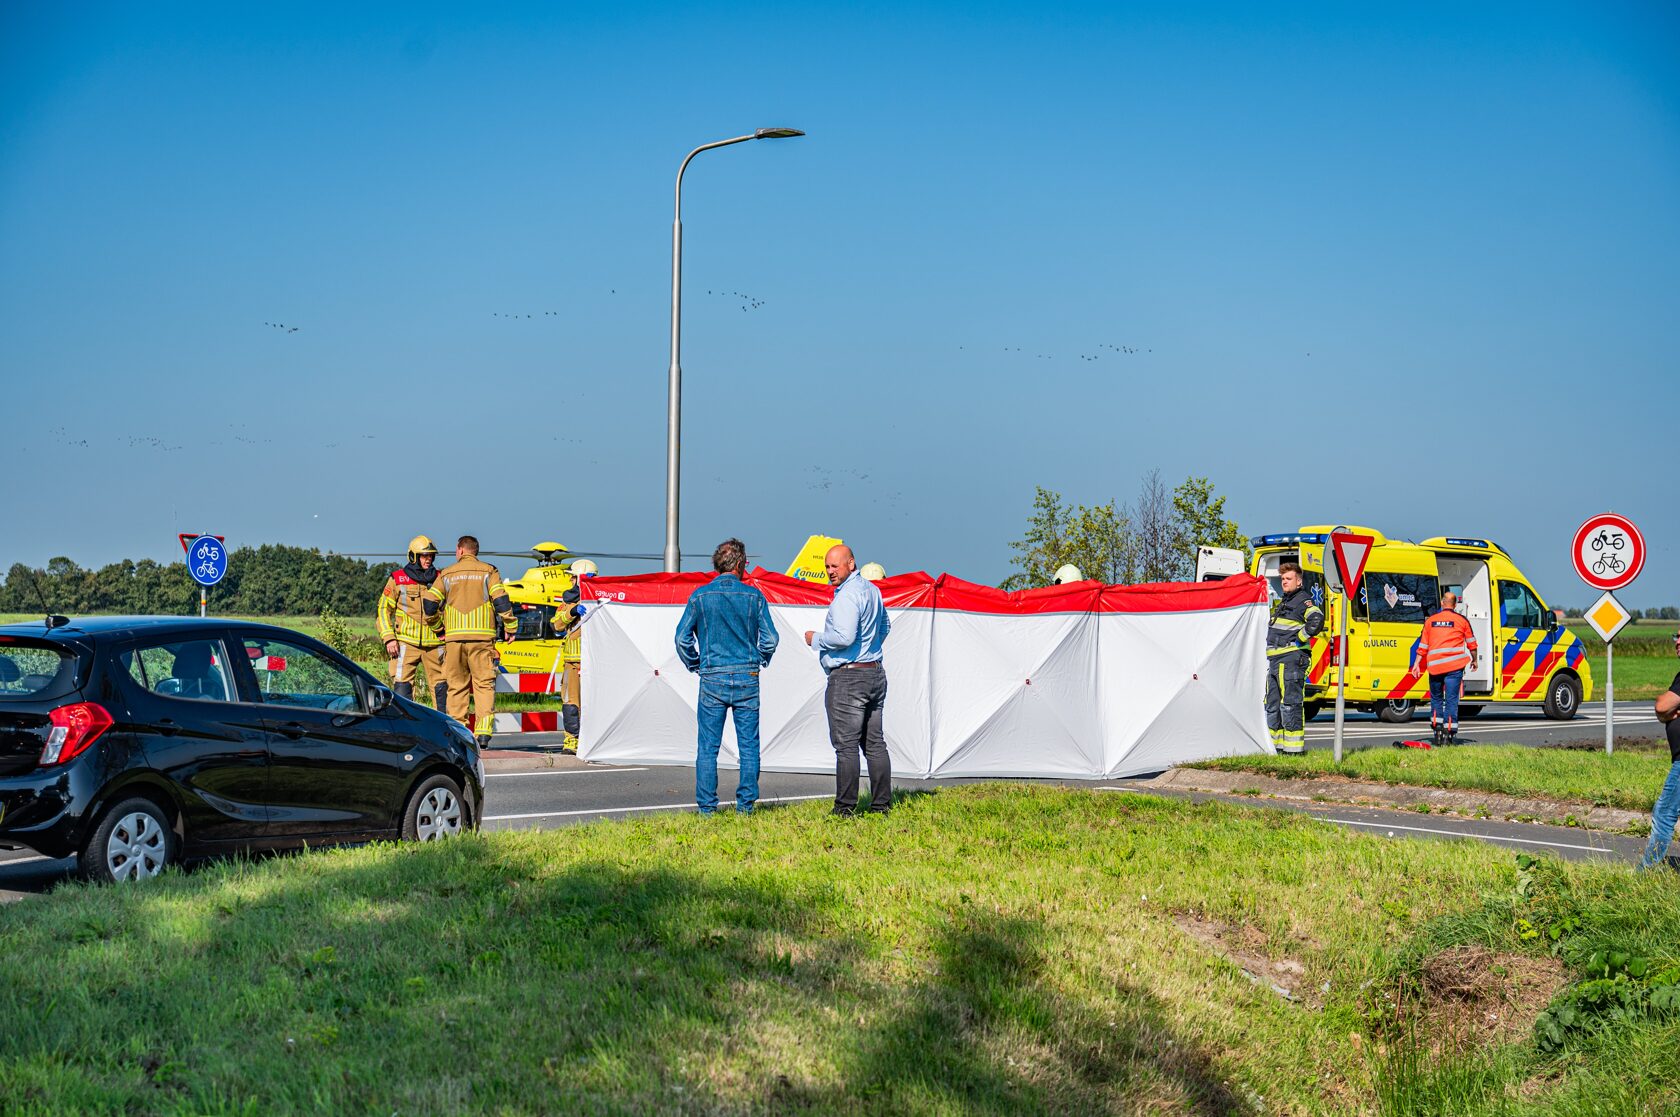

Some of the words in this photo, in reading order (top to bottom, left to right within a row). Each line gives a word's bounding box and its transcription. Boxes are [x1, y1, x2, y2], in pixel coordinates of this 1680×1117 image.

[800, 570, 826, 578] anwb
[398, 575, 410, 583] BV
[504, 650, 539, 658] AMBULANCE
